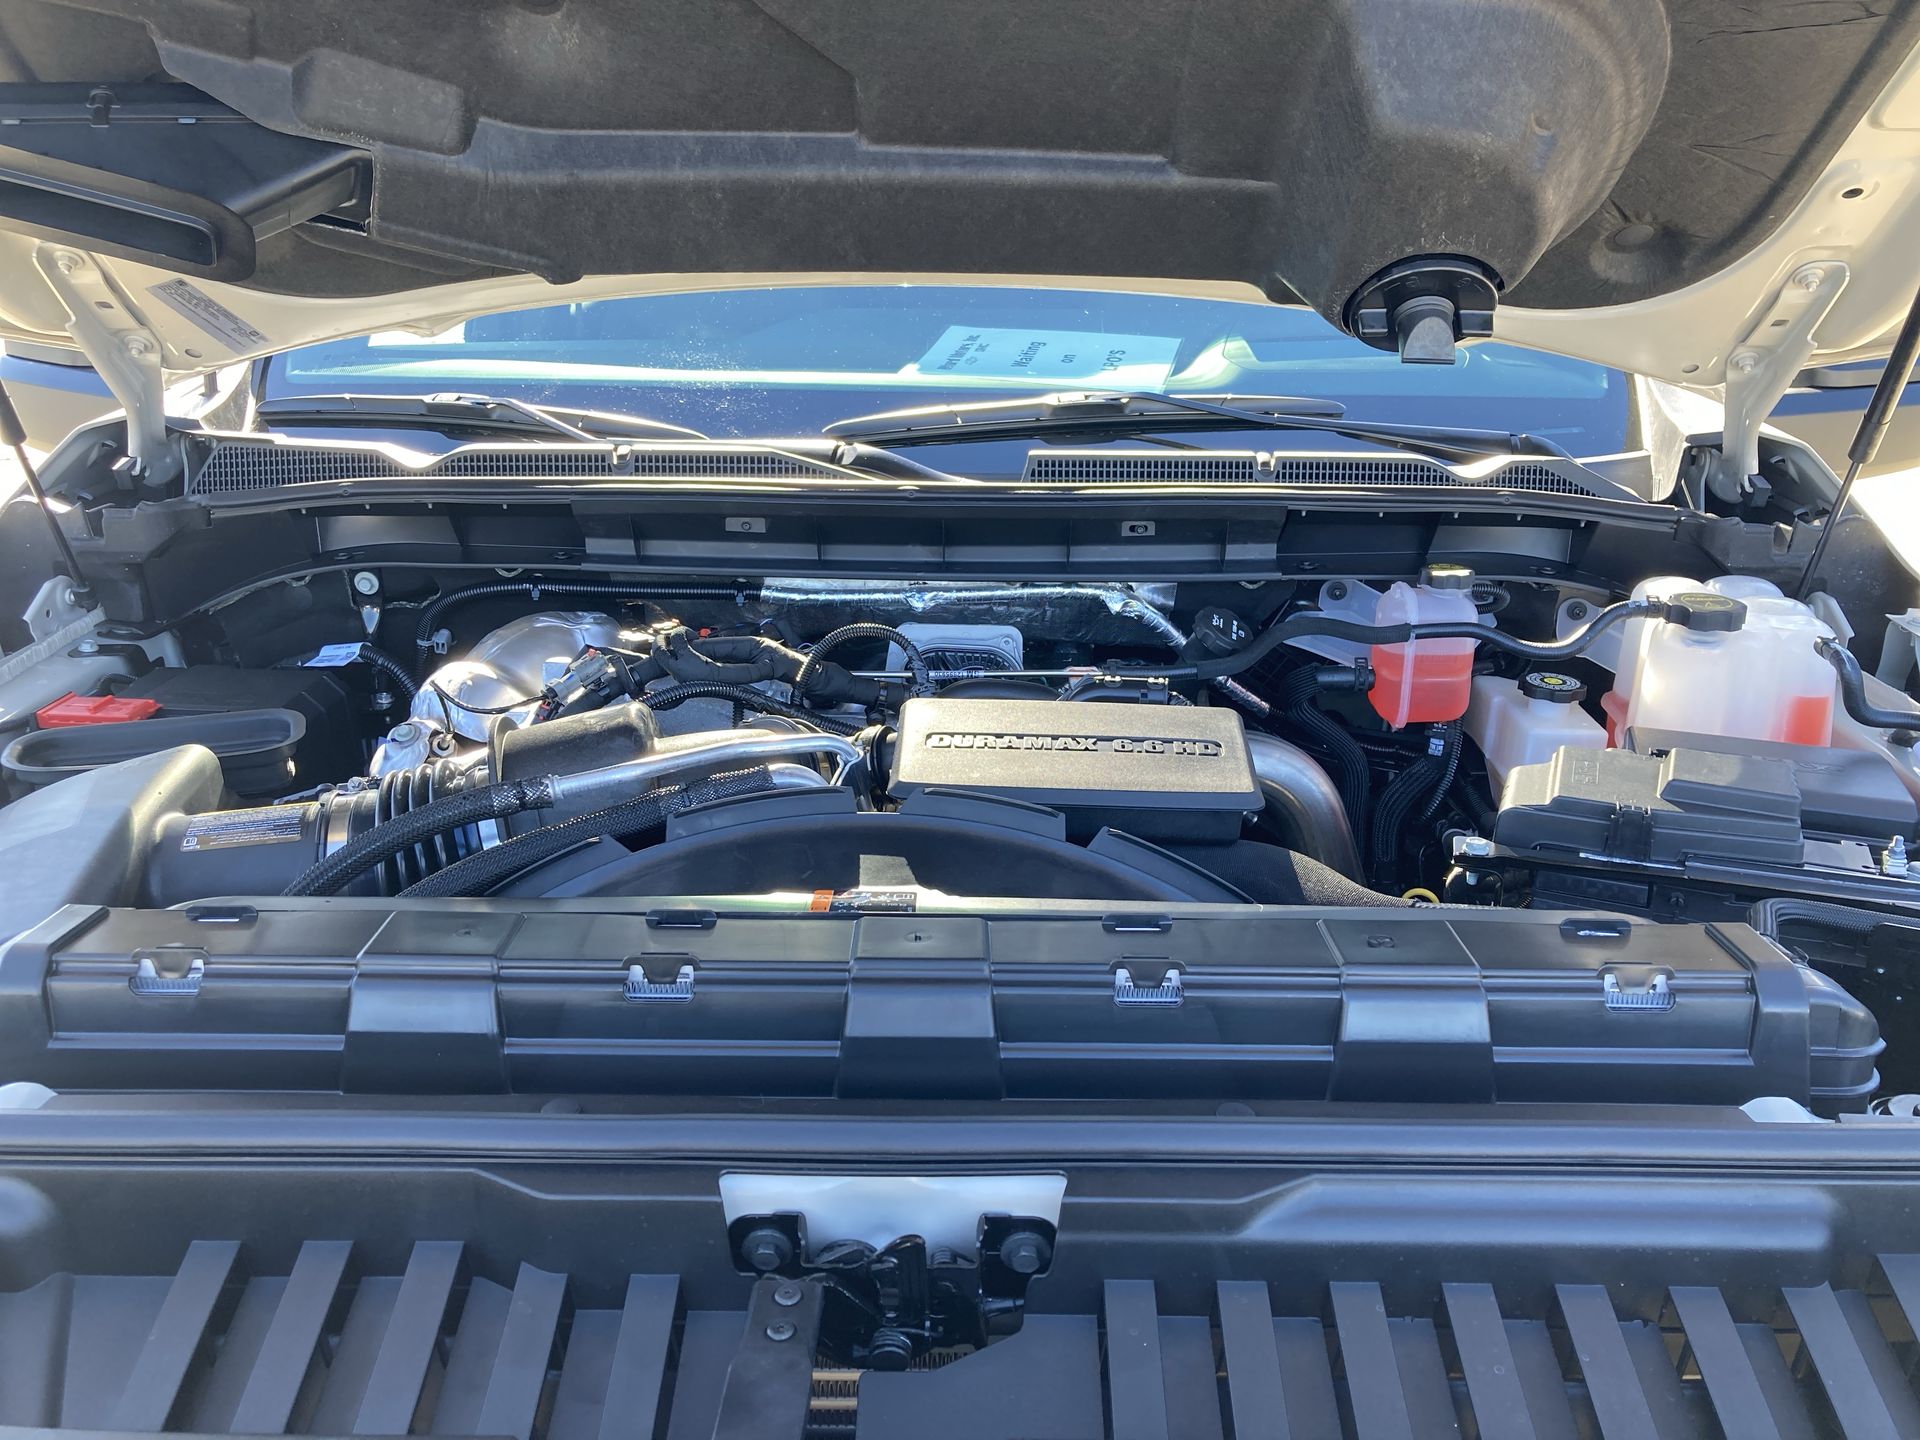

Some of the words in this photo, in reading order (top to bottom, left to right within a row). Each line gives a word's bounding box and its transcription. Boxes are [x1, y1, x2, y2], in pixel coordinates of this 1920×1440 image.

[1011, 341, 1047, 368] Waiting
[1061, 353, 1077, 364] on
[928, 734, 1099, 752] DURAMAX
[1112, 737, 1166, 754] 6.6
[1172, 740, 1220, 757] HD
